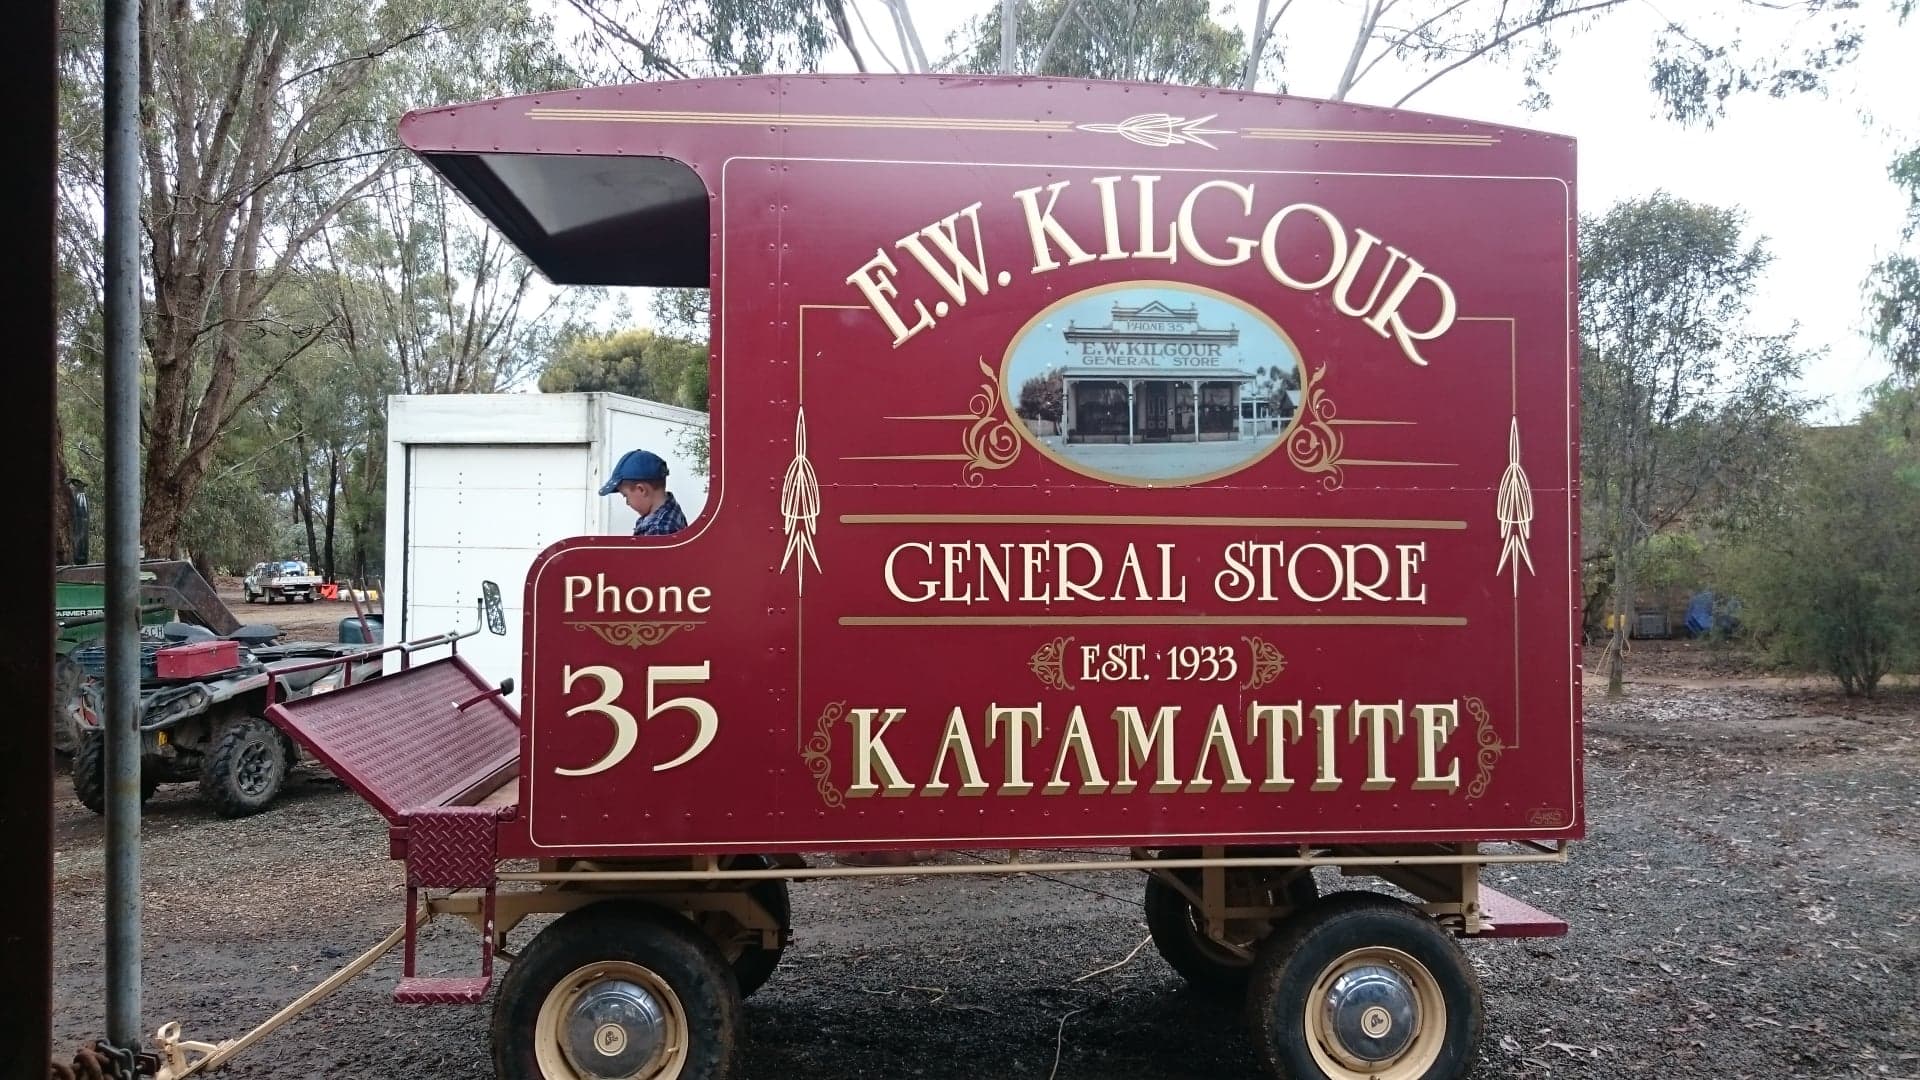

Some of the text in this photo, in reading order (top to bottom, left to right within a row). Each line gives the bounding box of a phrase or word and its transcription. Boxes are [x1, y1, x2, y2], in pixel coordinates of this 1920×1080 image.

[846, 175, 1456, 365] E.W. KILGOUR
[1127, 321, 1185, 332] PHONE 35
[1082, 356, 1220, 367] GENERAL STORE
[564, 573, 712, 614] Phone
[884, 540, 1428, 605] GENERAL STORE
[1080, 643, 1238, 683] EST. 1933
[554, 660, 719, 776] 35
[845, 699, 1461, 797] KATAMATITE
